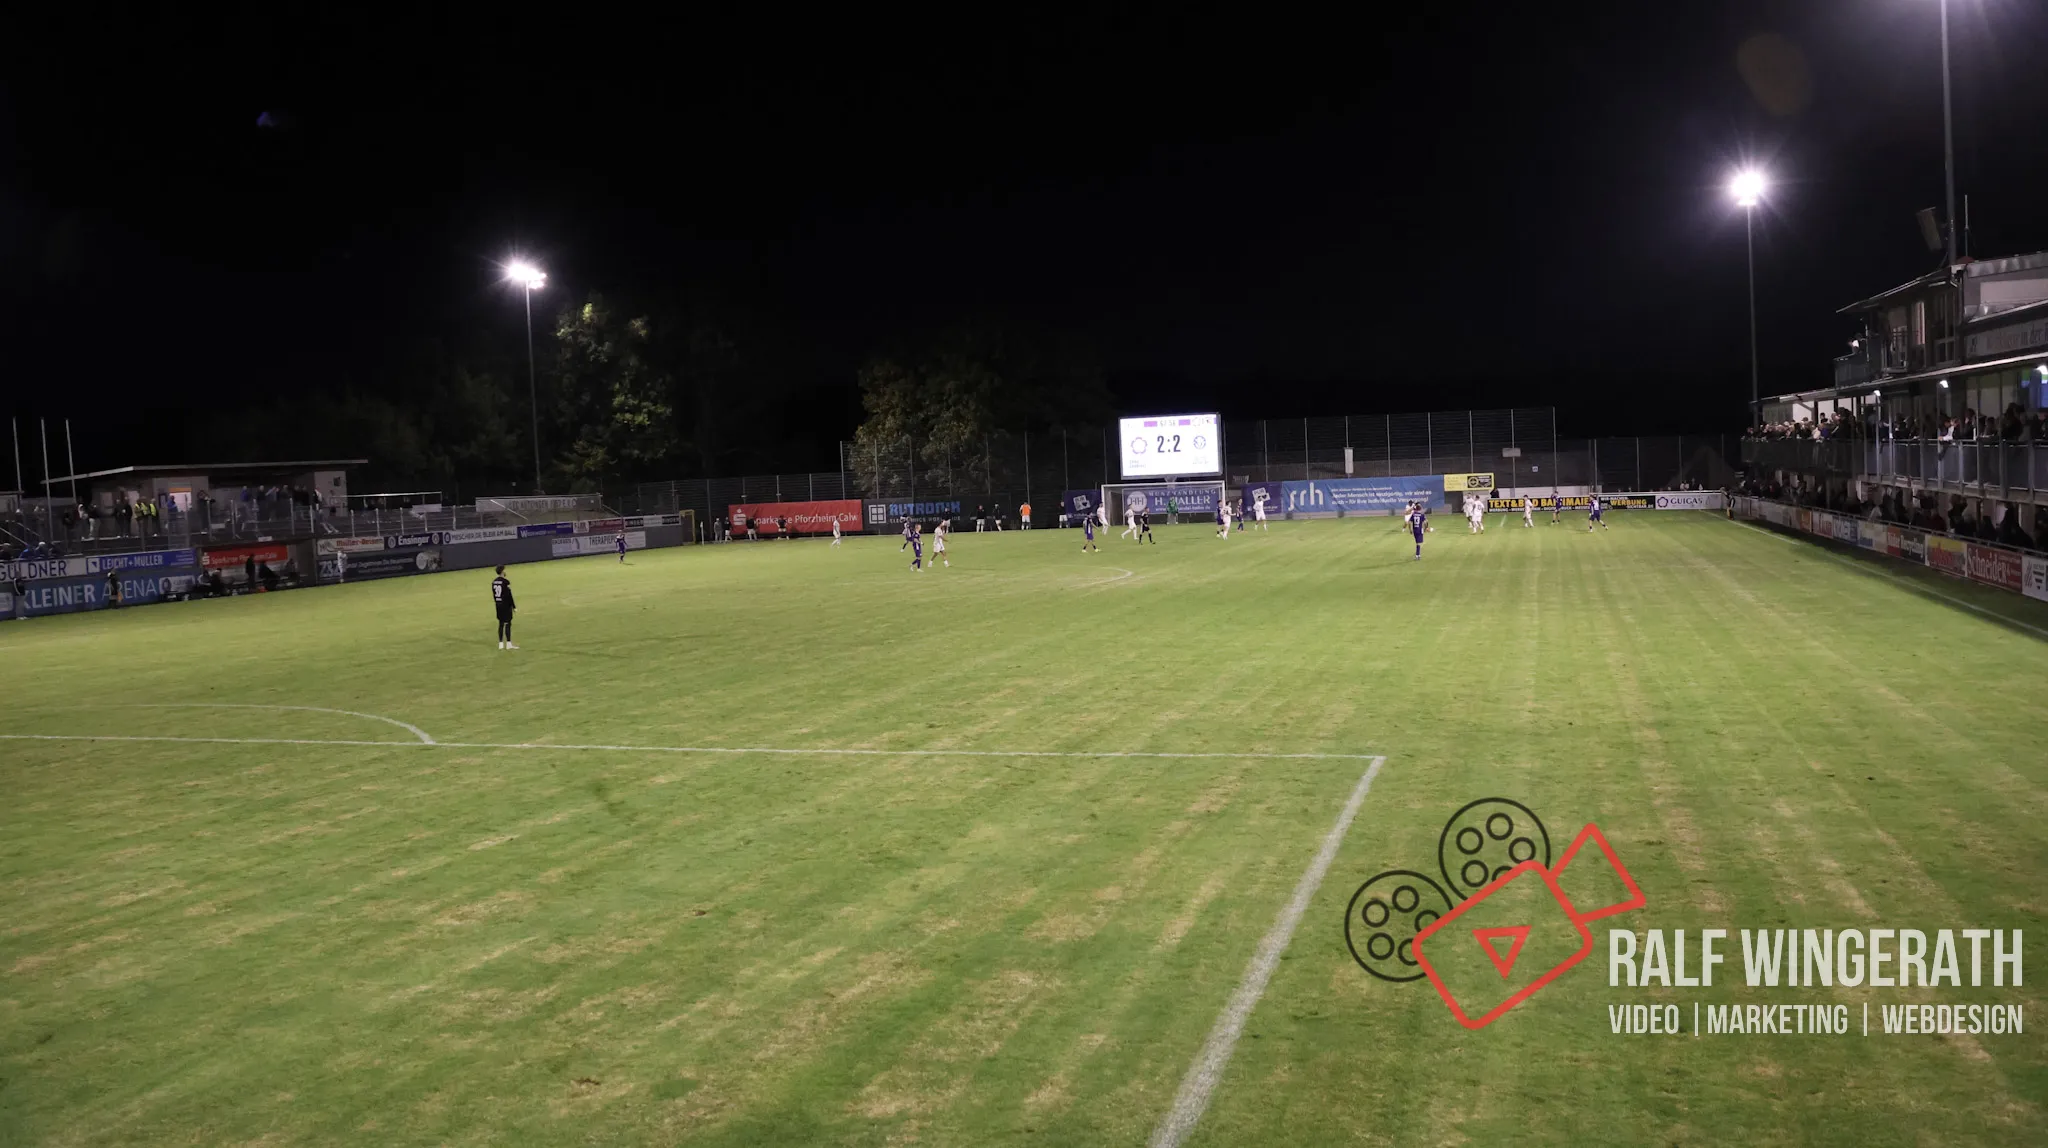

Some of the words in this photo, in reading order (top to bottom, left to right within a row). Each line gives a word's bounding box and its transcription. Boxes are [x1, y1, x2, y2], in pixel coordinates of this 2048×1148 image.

[1157, 434, 1181, 453] 2:2
[1288, 481, 1324, 511] srh
[1610, 499, 1647, 507] WERBUNG
[839, 512, 858, 522] Calw
[1413, 516, 1420, 525] 13
[398, 535, 430, 546] Ensinger
[1967, 547, 2008, 584] Schneider
